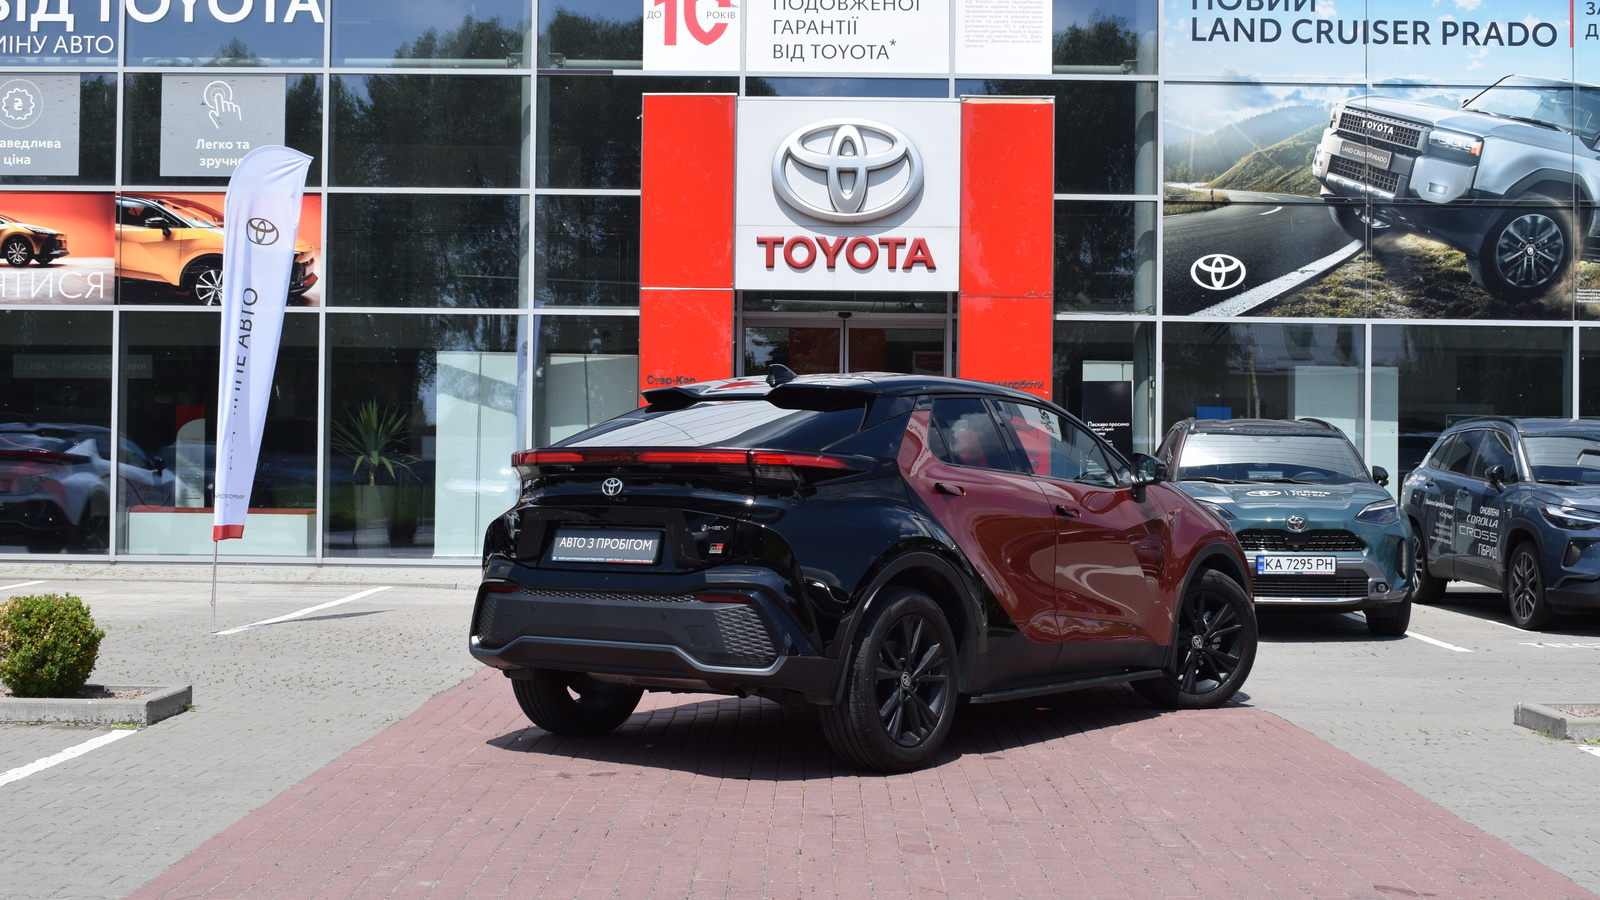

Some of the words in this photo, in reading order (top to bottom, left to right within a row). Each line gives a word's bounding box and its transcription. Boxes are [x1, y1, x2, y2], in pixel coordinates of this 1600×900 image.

[647, 11, 662, 19] ДО
[706, 11, 736, 19] РОКІВ
[773, 16, 859, 35] ГАРАНТІЇ
[1191, 17, 1282, 43] LAND
[1291, 19, 1432, 46] CRUISER
[1441, 21, 1558, 48] PRADO
[53, 35, 115, 54] АВТО
[773, 44, 805, 62] ВІД
[1361, 119, 1394, 135] TOYOTA
[195, 138, 234, 150] Легко
[236, 141, 250, 150] та
[3, 153, 31, 166] ціна
[756, 236, 937, 270] TOYOTA
[1466, 514, 1499, 529] COROLLA
[1459, 525, 1498, 543] CROSS
[559, 537, 586, 549] АВТО
[587, 537, 594, 549] З
[596, 538, 653, 551] ПРОБІГОМ
[1265, 558, 1283, 570] KA
[1286, 558, 1313, 570] 7295
[1316, 558, 1333, 570] PH
